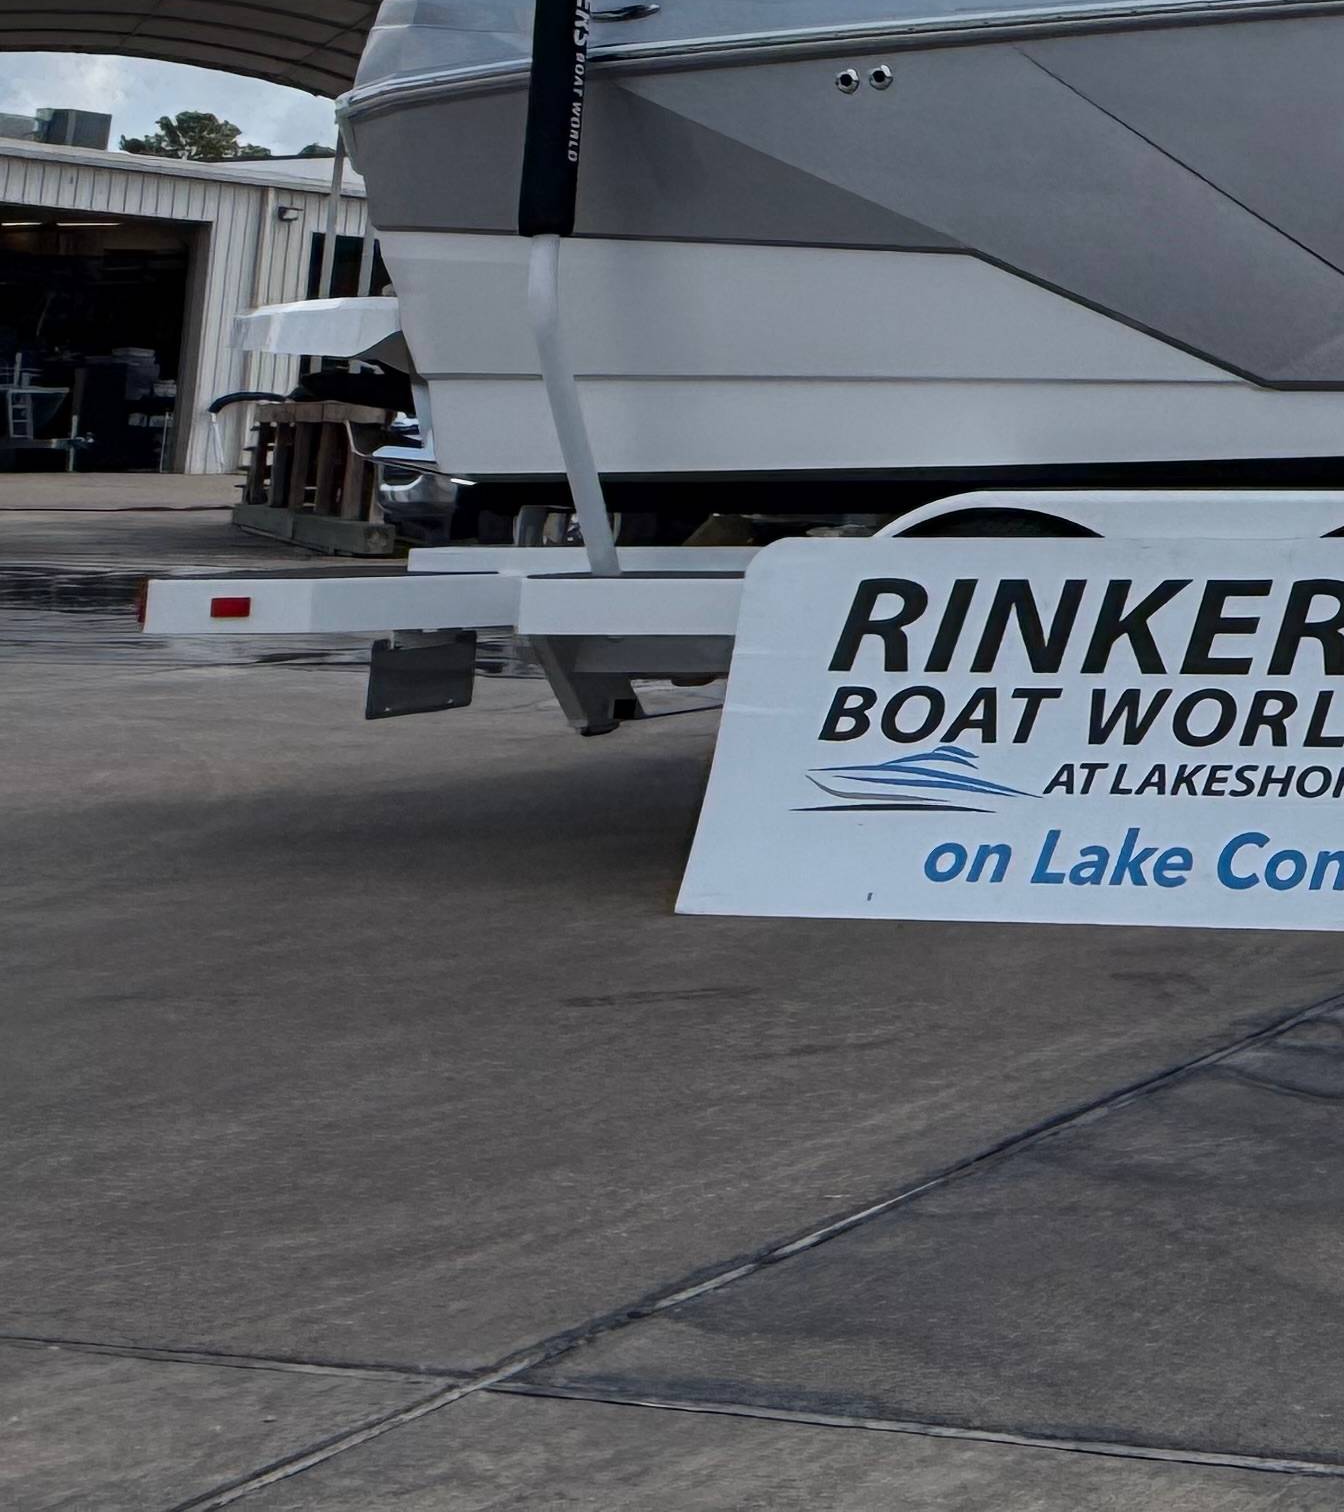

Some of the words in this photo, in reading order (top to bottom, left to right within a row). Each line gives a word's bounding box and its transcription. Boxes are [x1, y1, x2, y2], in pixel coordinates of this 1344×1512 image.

[567, 102, 582, 162] WORLD
[818, 686, 1062, 745] BOAT
[1042, 763, 1098, 795] AT
[922, 840, 1012, 885] on
[1029, 826, 1193, 888] Lake
